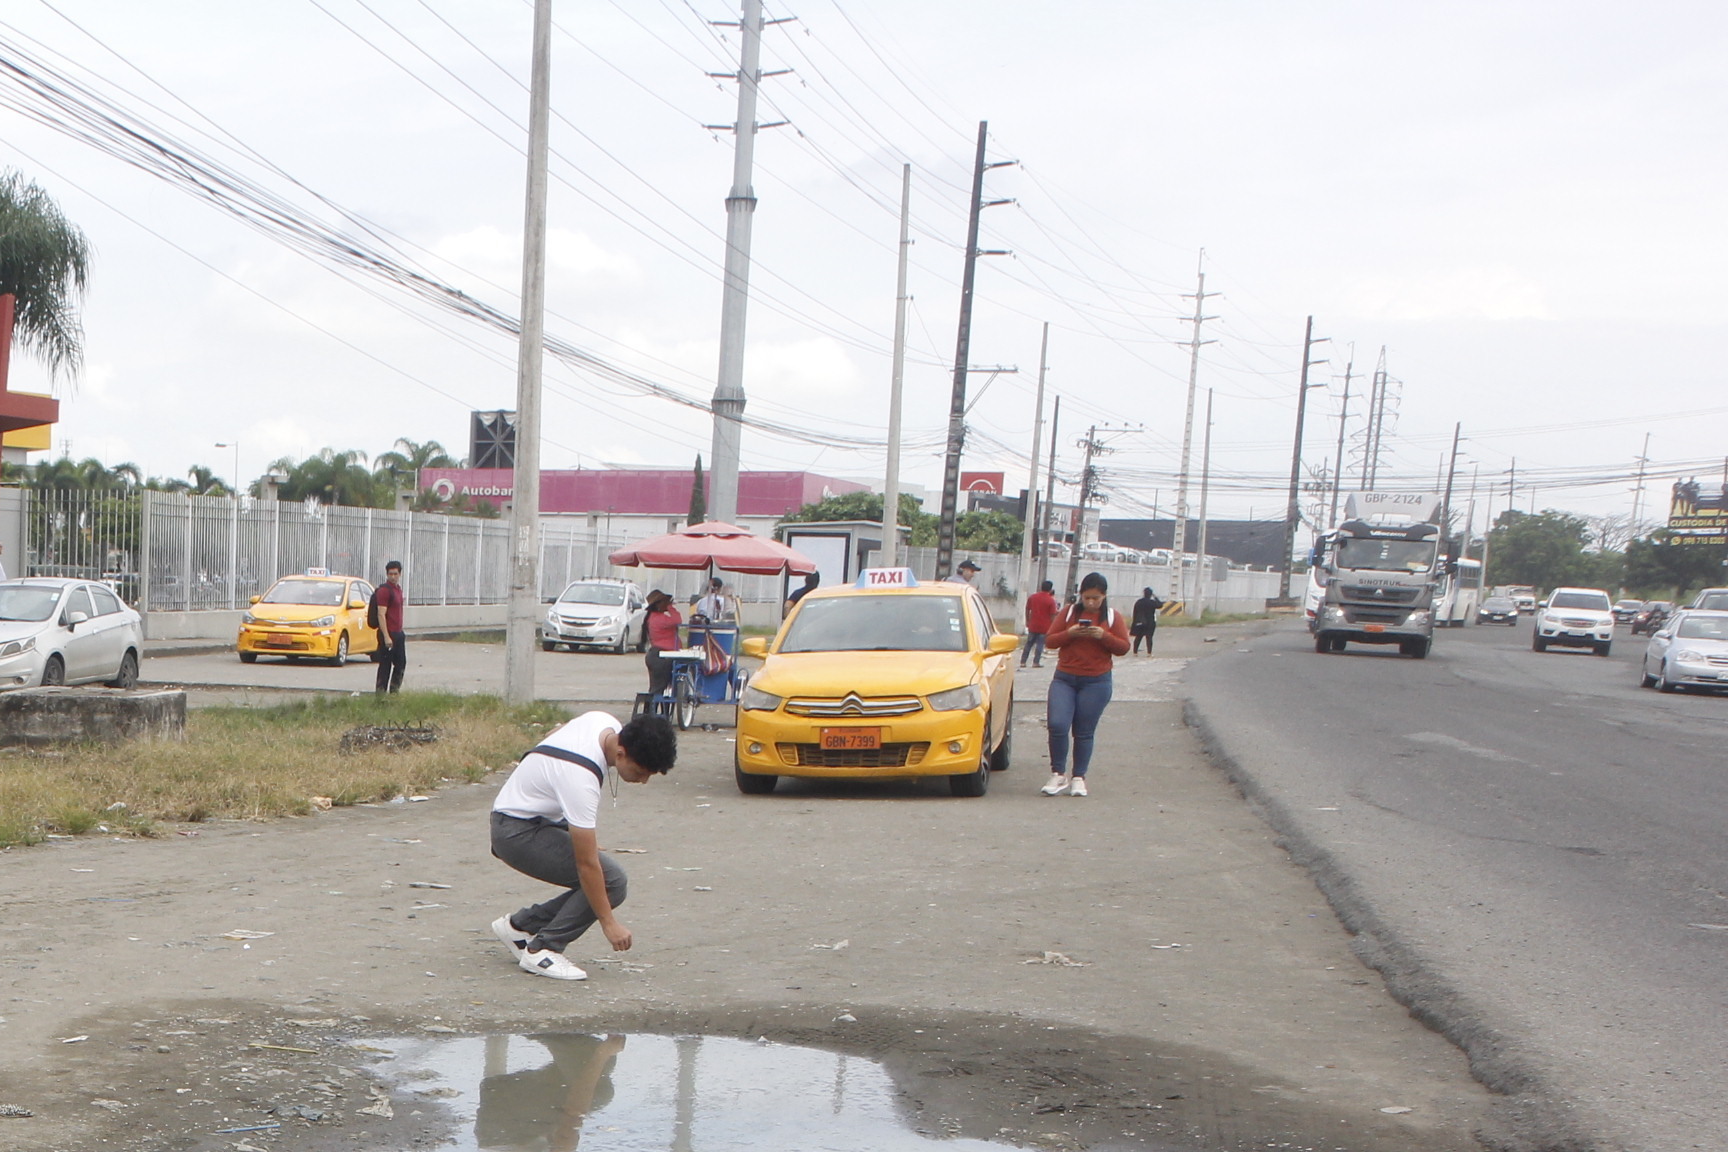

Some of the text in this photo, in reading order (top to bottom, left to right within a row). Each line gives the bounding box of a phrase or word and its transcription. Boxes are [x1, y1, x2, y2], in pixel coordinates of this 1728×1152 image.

[1364, 493, 1423, 505] GBP-2124
[869, 571, 903, 584] TAXI
[1358, 578, 1401, 587] SINOTRUK
[825, 735, 875, 748] GBN-7399
